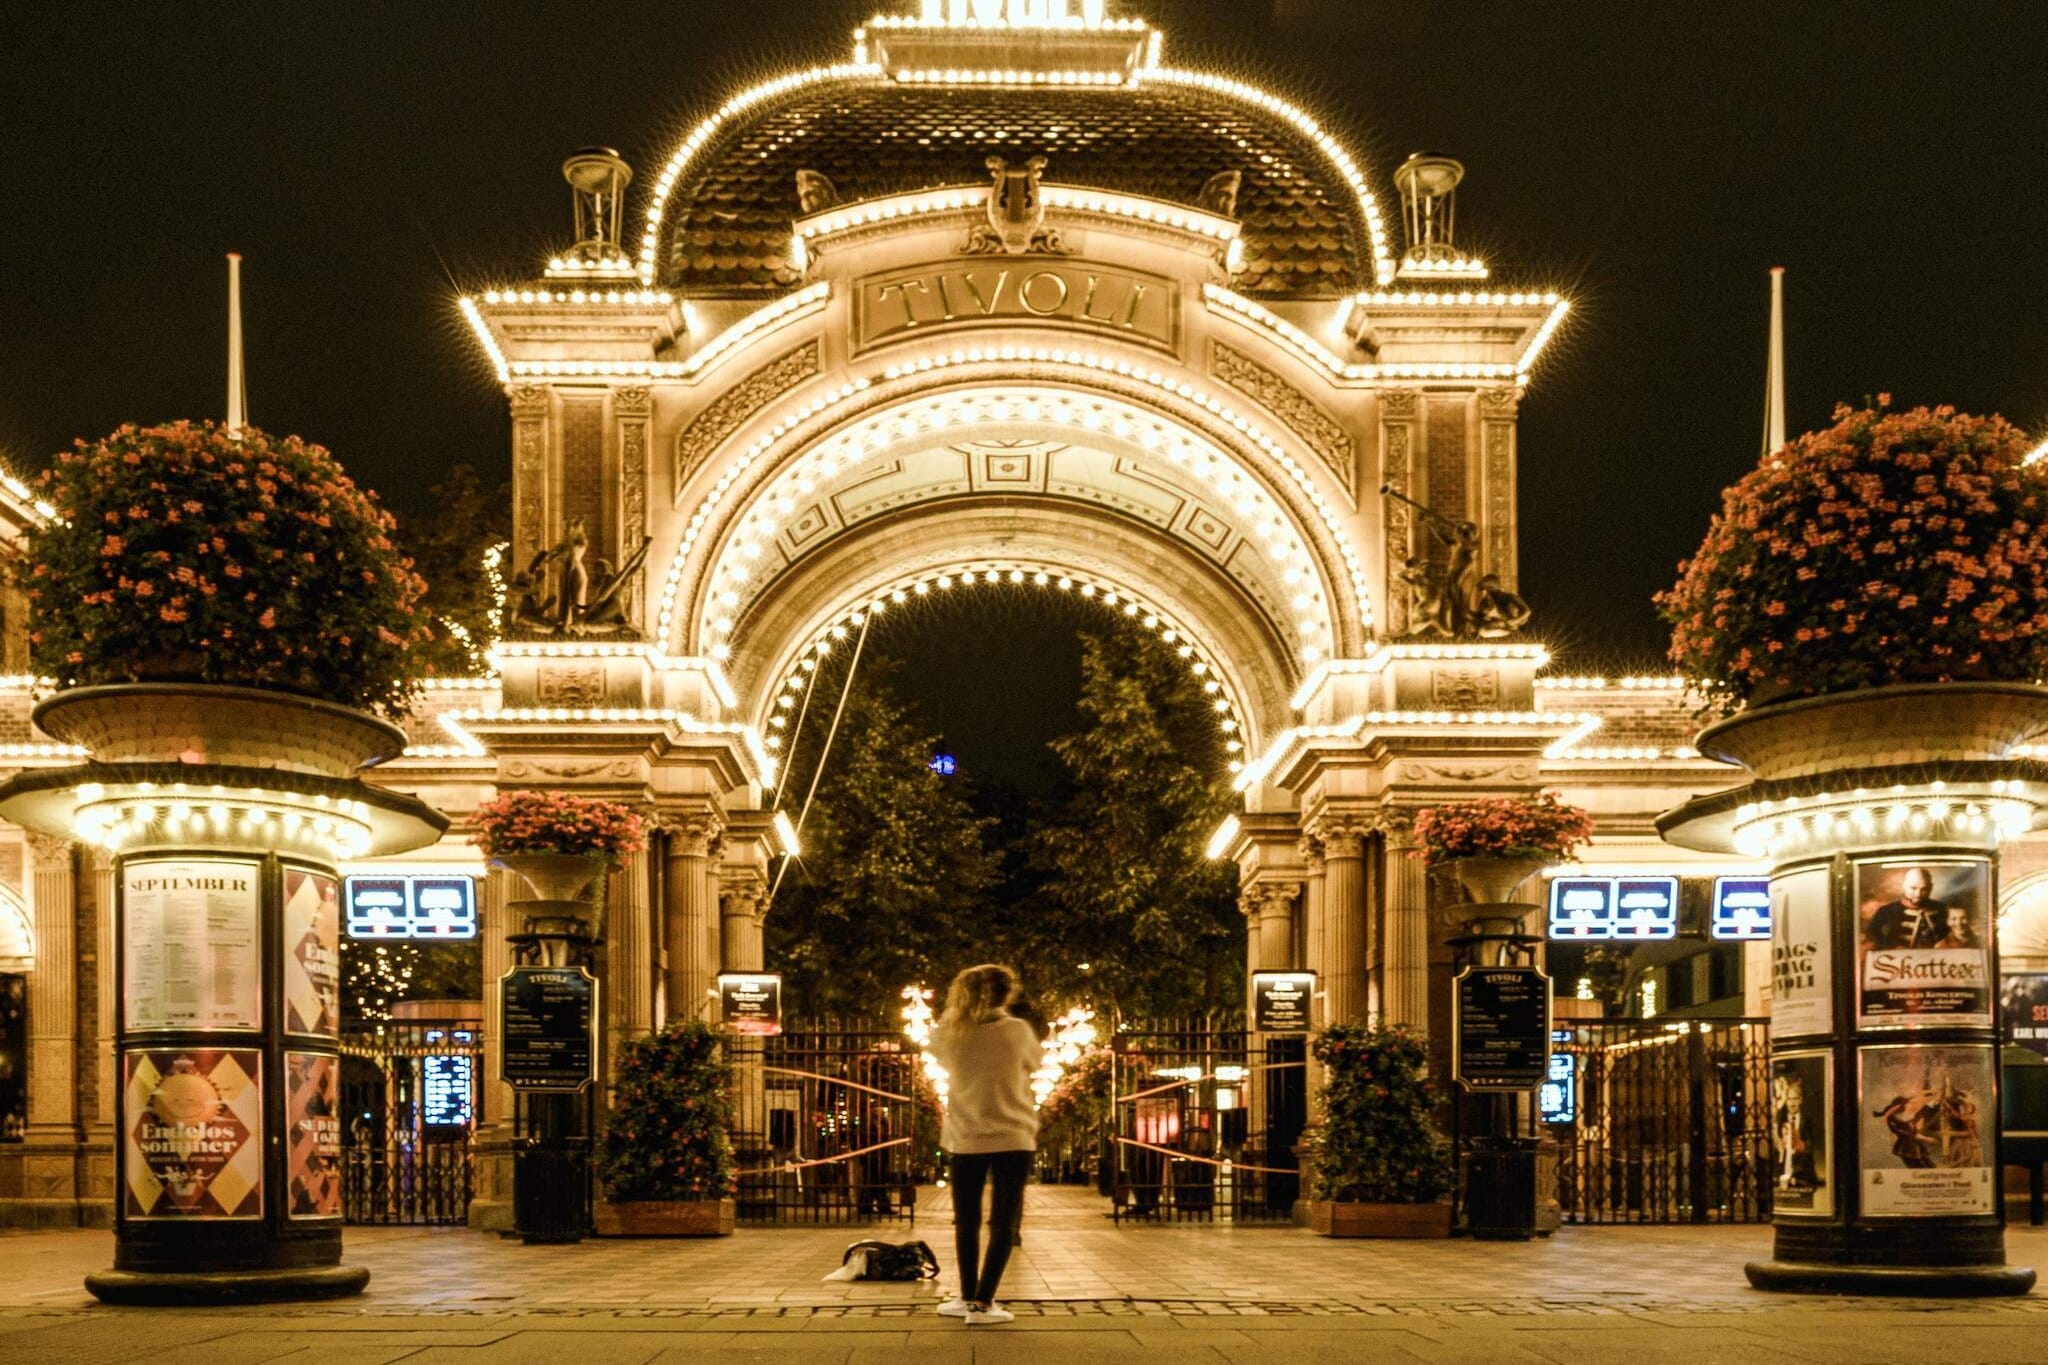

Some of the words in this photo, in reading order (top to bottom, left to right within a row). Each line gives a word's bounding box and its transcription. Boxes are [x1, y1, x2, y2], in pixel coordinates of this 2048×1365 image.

[879, 269, 1147, 328] TIVOLI
[129, 877, 248, 892] SEPTEMBER
[528, 973, 568, 983] TIVOLI
[1484, 973, 1523, 983] TIVOLI
[140, 1140, 237, 1153] sommer
